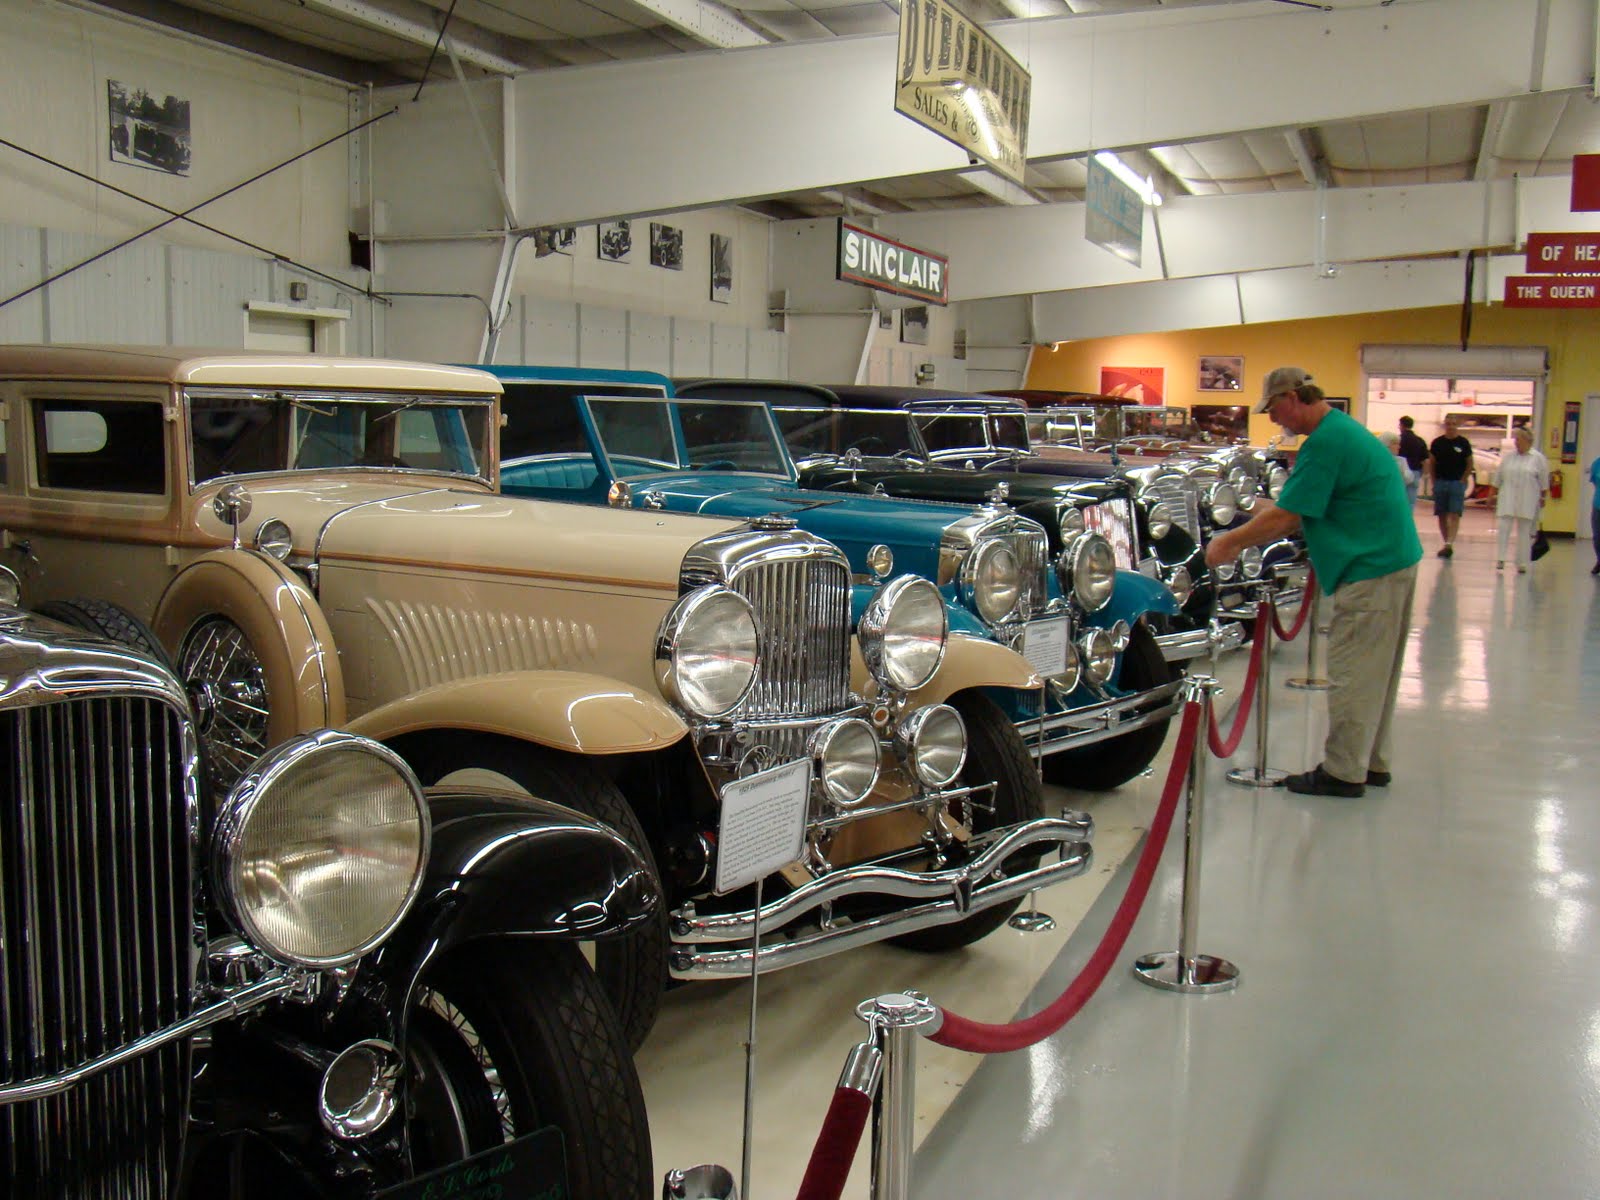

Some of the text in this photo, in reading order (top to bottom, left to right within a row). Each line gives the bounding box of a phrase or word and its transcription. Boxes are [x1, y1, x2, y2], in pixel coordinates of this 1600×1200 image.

[914, 86, 949, 126] SALES
[951, 111, 959, 133] &
[845, 232, 941, 293] SINCLAIR
[1541, 245, 1564, 261] OF
[1517, 286, 1595, 299] THE QUEEN
